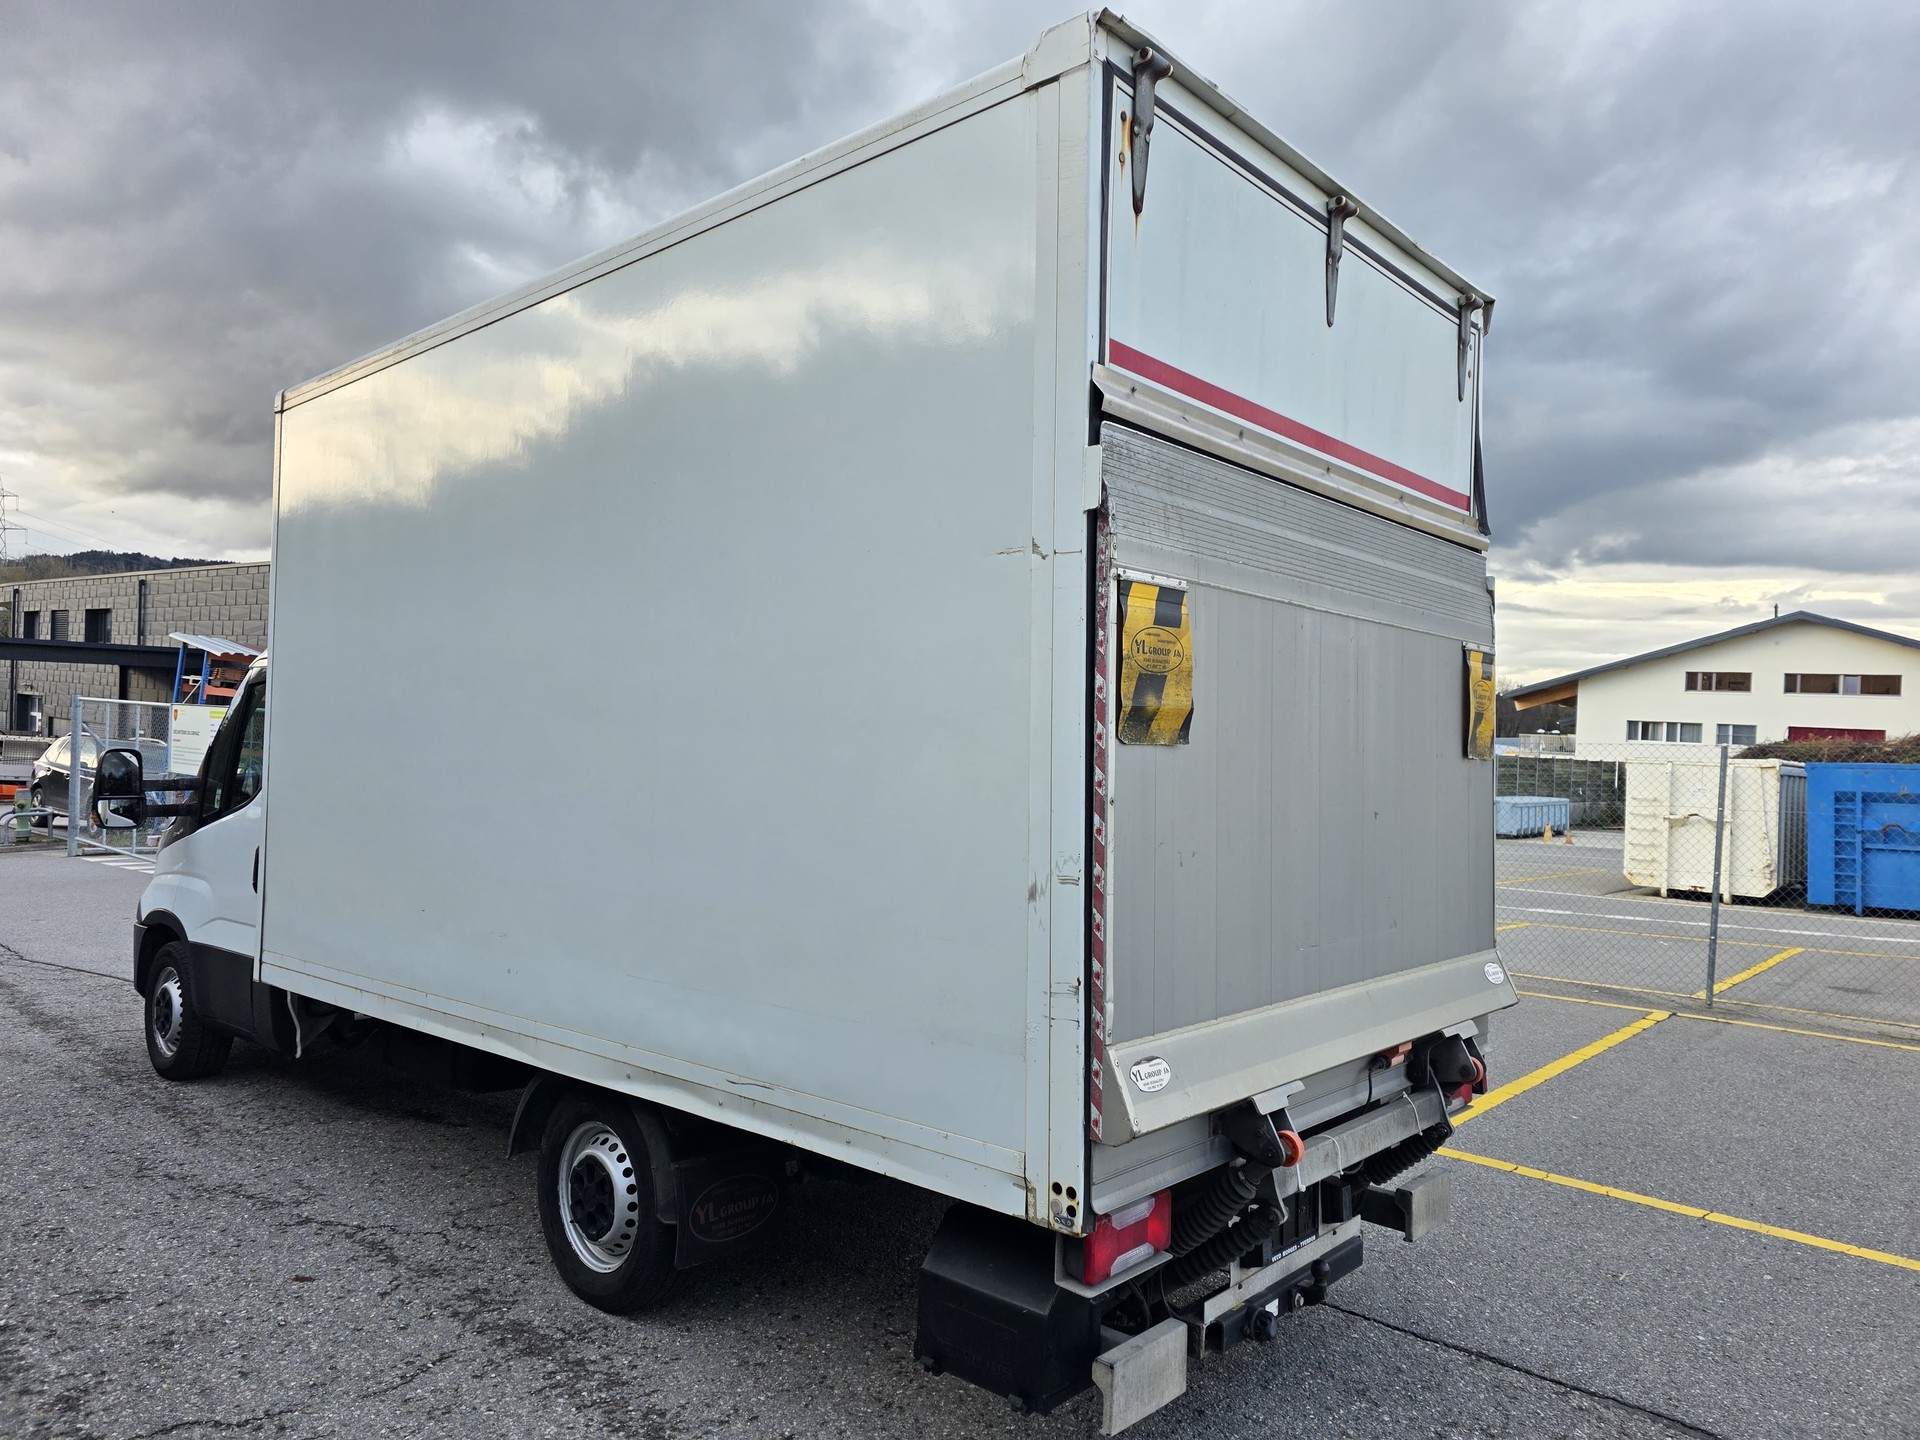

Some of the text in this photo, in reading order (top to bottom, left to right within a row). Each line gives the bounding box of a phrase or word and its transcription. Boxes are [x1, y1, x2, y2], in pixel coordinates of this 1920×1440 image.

[1135, 638, 1147, 654] YL
[1148, 646, 1171, 656] GROUP
[1131, 1069, 1145, 1082] YL
[1144, 1068, 1162, 1079] GROUP
[695, 1201, 719, 1225] YL
[720, 1196, 759, 1218] GROUP
